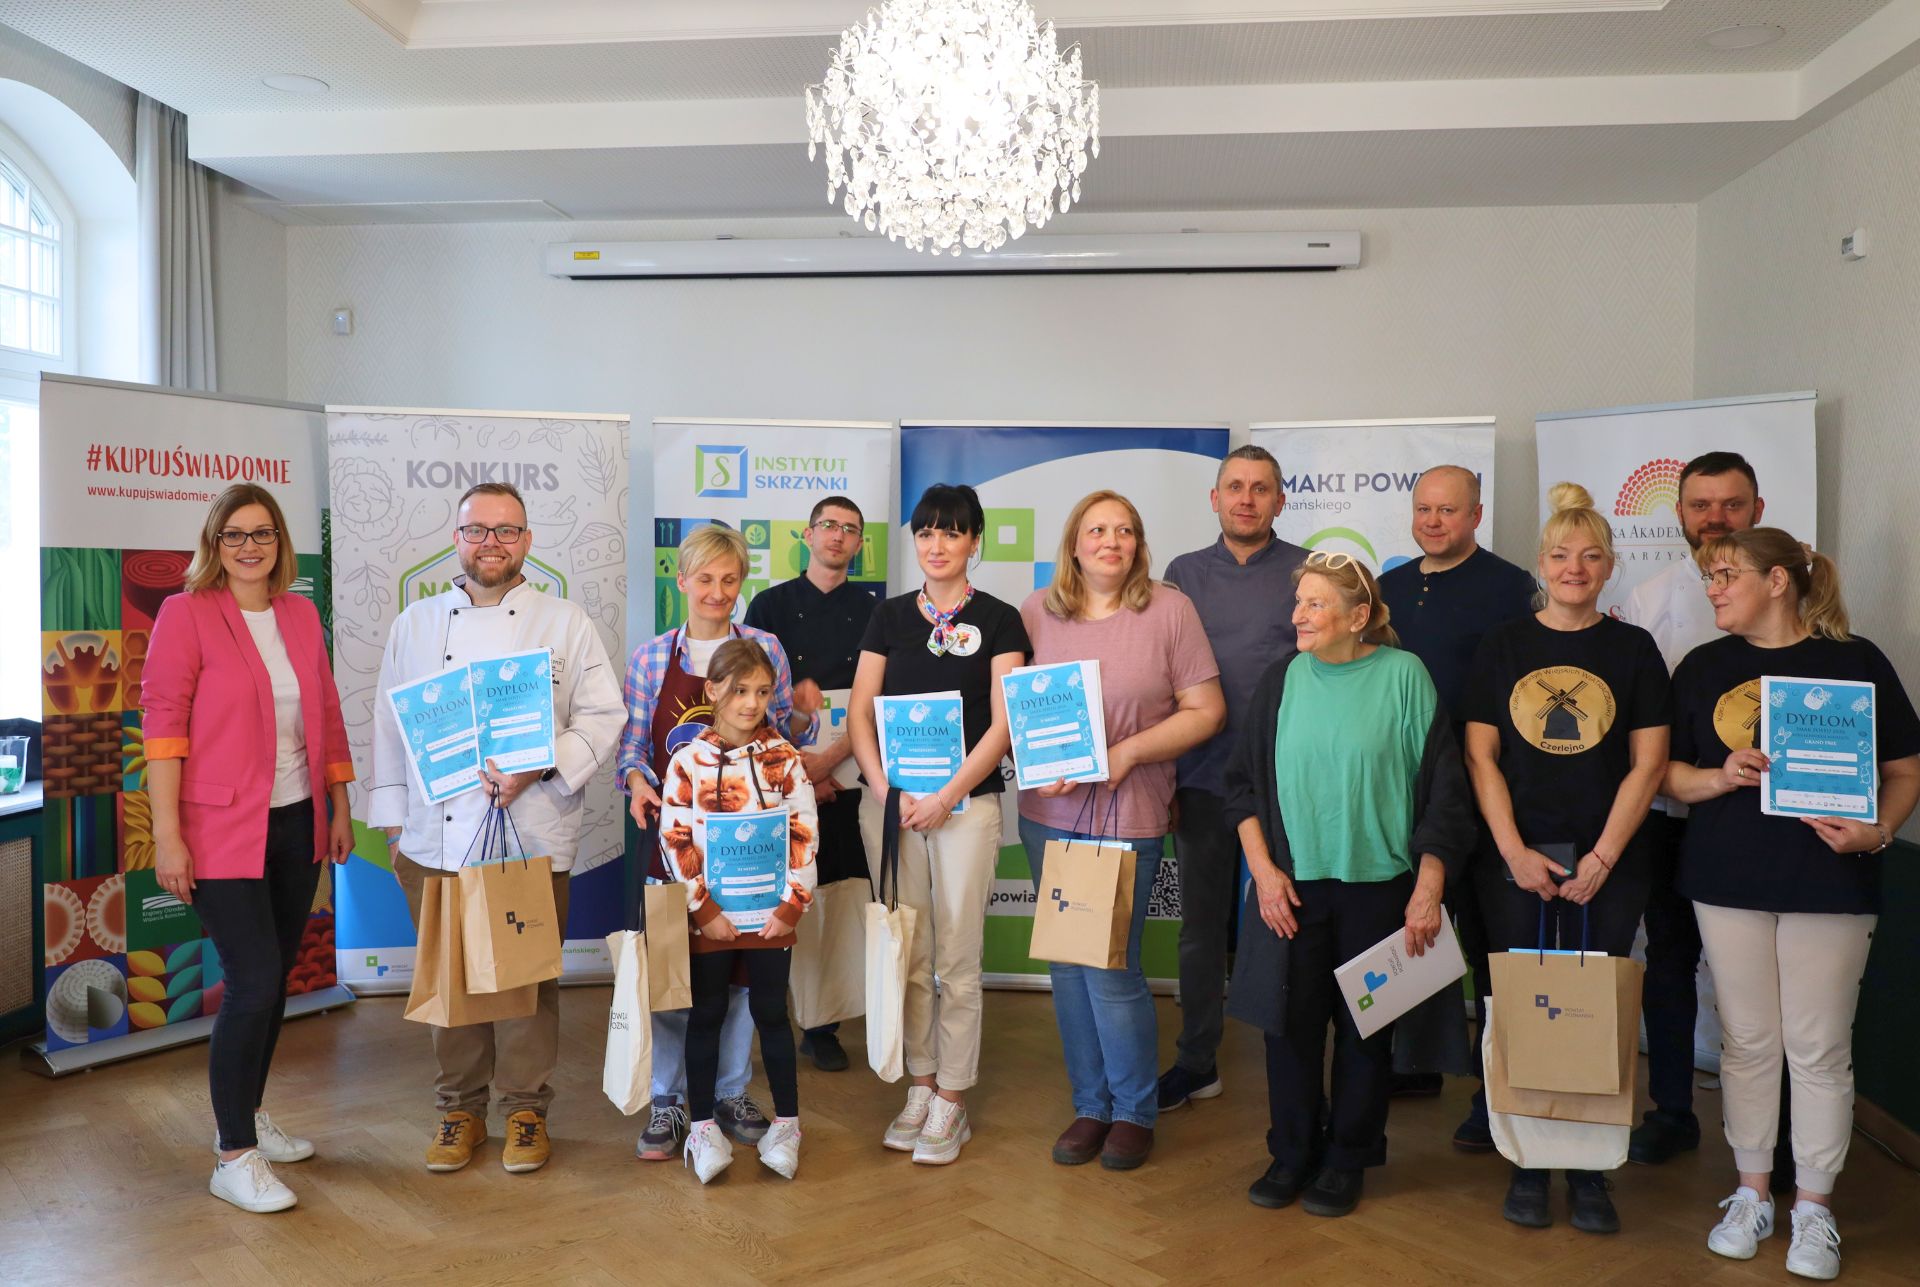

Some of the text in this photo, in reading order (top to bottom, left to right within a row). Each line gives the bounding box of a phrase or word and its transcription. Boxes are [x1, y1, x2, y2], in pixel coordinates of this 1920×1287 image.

[87, 443, 291, 484] #KUPUJŚWIADOMIE
[754, 456, 848, 472] INSTYTUT
[406, 460, 560, 491] KONKURS
[755, 475, 848, 490] SKRZYNKI
[1282, 473, 1346, 493] MAKI
[87, 485, 217, 502] www.kupujswiadomie.
[1284, 498, 1351, 514] nańskiego
[1629, 523, 1686, 539] AKADEM
[1615, 551, 1687, 561] WARZYS
[486, 681, 540, 698] DYPLOM
[1021, 691, 1073, 710] DYPLOM
[415, 697, 469, 724] DYPLOM
[1786, 712, 1856, 728] DYPLOM
[896, 726, 949, 737] DYPLOM
[1540, 741, 1585, 753] Czerlejno
[720, 843, 775, 856] DYPLOM
[990, 890, 1038, 906] powia
